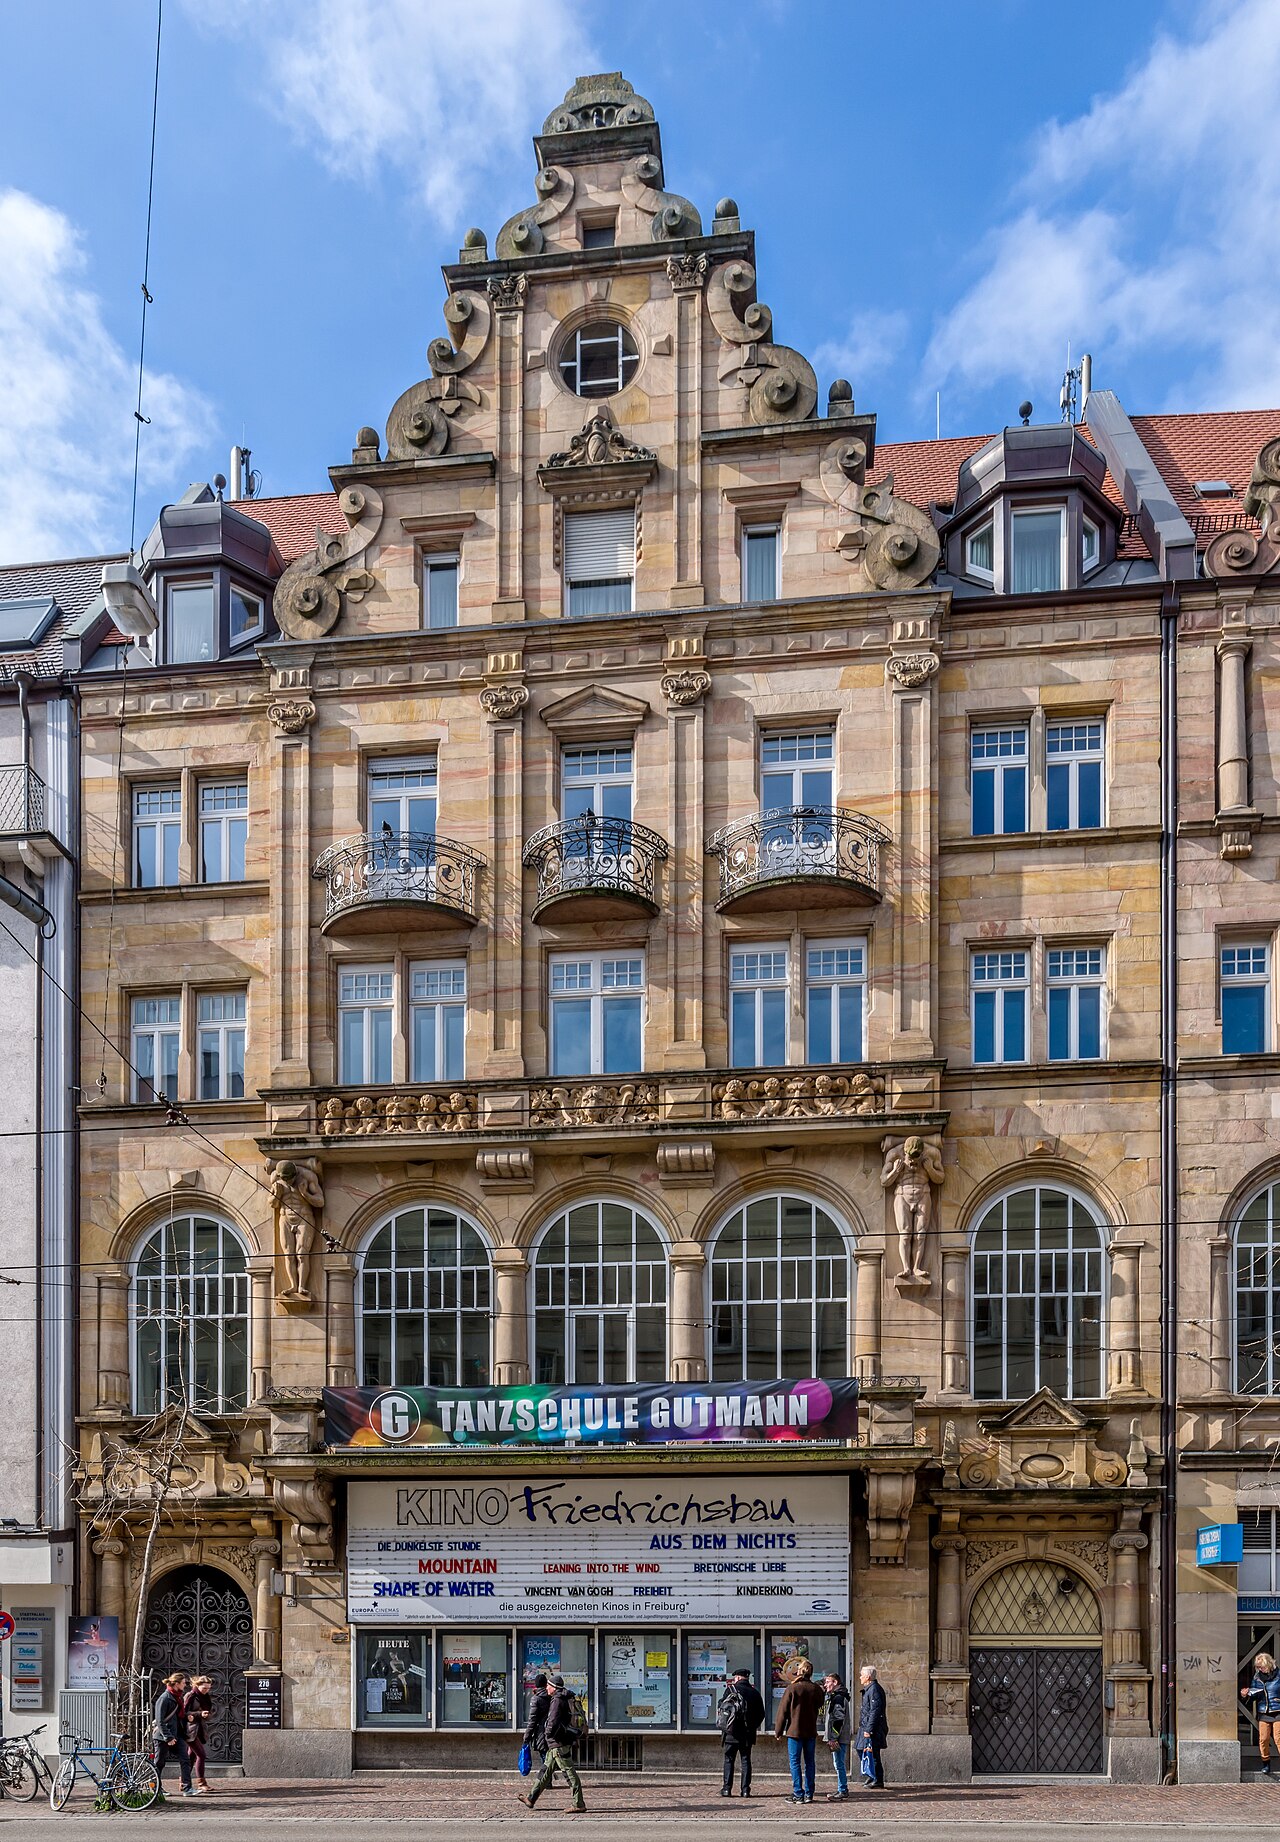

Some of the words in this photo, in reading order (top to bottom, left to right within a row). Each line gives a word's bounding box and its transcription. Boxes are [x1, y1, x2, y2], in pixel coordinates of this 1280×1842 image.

[380, 1396, 410, 1438] G
[436, 1398, 639, 1432] TANZSCHULE
[651, 1394, 808, 1429] GUTMANN
[396, 1487, 509, 1526] KINO
[509, 1482, 795, 1526] Friedrichsbau
[377, 1541, 391, 1551] DIE
[395, 1541, 443, 1551] DUNKELSTE
[447, 1541, 481, 1551] STUNDE
[650, 1534, 683, 1550] AUS
[692, 1534, 727, 1549] DEM
[737, 1533, 796, 1549] NICHTS
[418, 1559, 497, 1574] MOUNTAIN
[543, 1564, 581, 1573] LEANING
[586, 1563, 609, 1573] INTO
[612, 1563, 629, 1573] THE
[635, 1563, 660, 1573] WIND
[694, 1563, 756, 1573] BRETONISCHE
[762, 1562, 787, 1572] LIEBE
[373, 1581, 419, 1597] SHAPE
[425, 1581, 443, 1597] OF
[448, 1581, 495, 1597] WATER
[524, 1586, 562, 1597] VINCENT
[567, 1586, 585, 1596] VAN
[633, 1586, 672, 1596] FREIHEIT
[736, 1585, 793, 1596] KINDERKINO
[499, 1602, 514, 1611] die
[516, 1602, 599, 1612] ausgezeichneten
[602, 1602, 629, 1611] Kinos
[632, 1602, 641, 1611] in
[378, 1640, 410, 1648] HEUTE
[528, 1648, 555, 1656] Project
